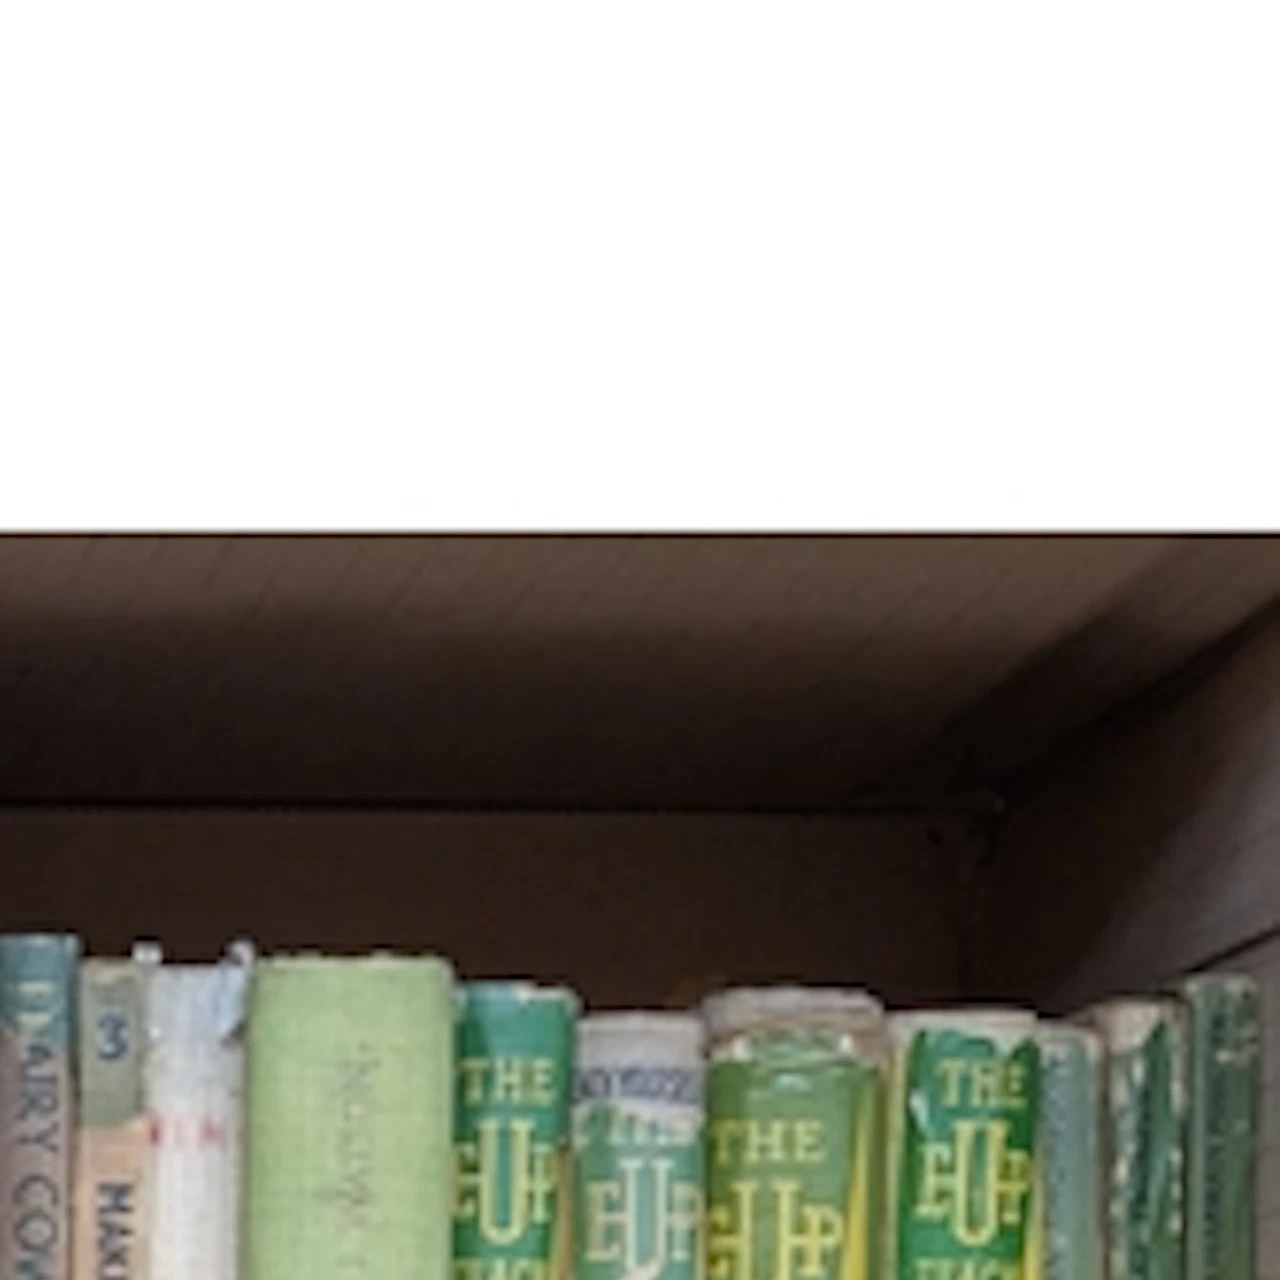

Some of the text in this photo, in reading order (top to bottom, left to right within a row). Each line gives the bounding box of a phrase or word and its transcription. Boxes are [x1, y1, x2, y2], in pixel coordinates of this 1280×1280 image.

[457, 1057, 556, 1105] THE
[939, 1059, 1029, 1108] THE
[712, 1118, 827, 1163] THE
